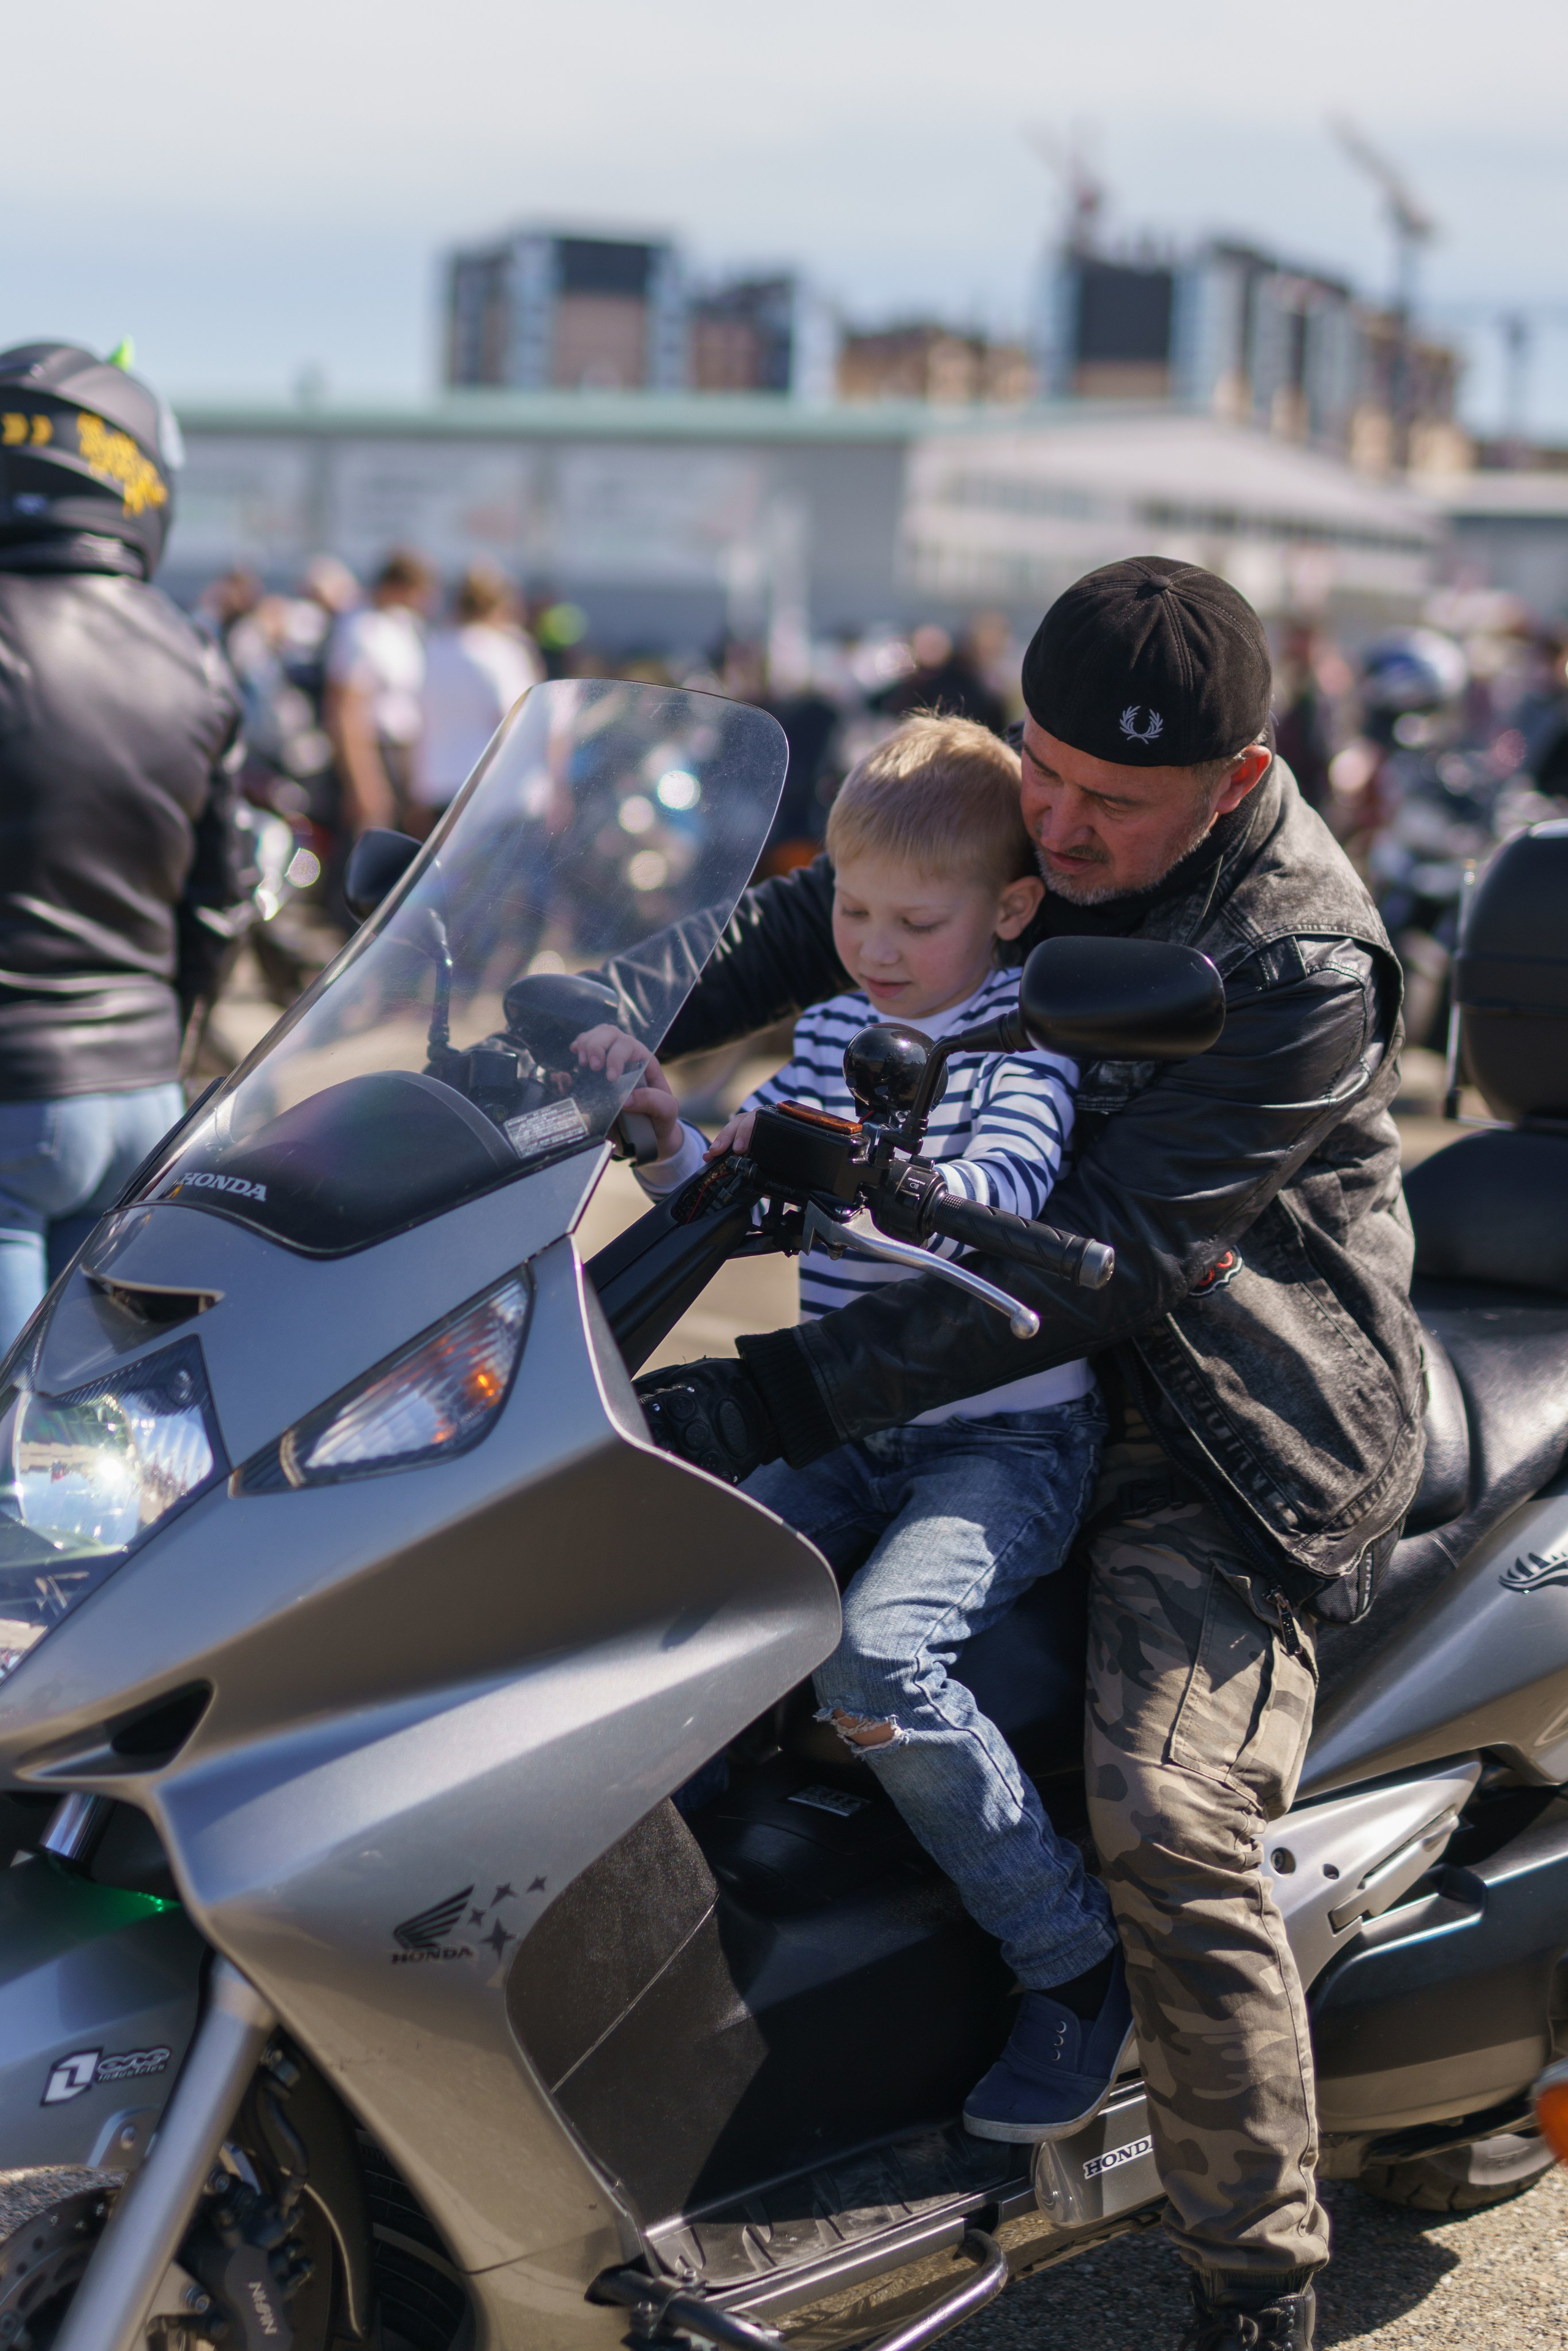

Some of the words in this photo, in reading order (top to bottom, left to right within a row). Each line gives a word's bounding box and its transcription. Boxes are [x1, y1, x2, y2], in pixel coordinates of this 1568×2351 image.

[177, 1172, 267, 1202] HONDA
[391, 1945, 474, 1964] HONDA
[1085, 2140, 1153, 2176] HOND
